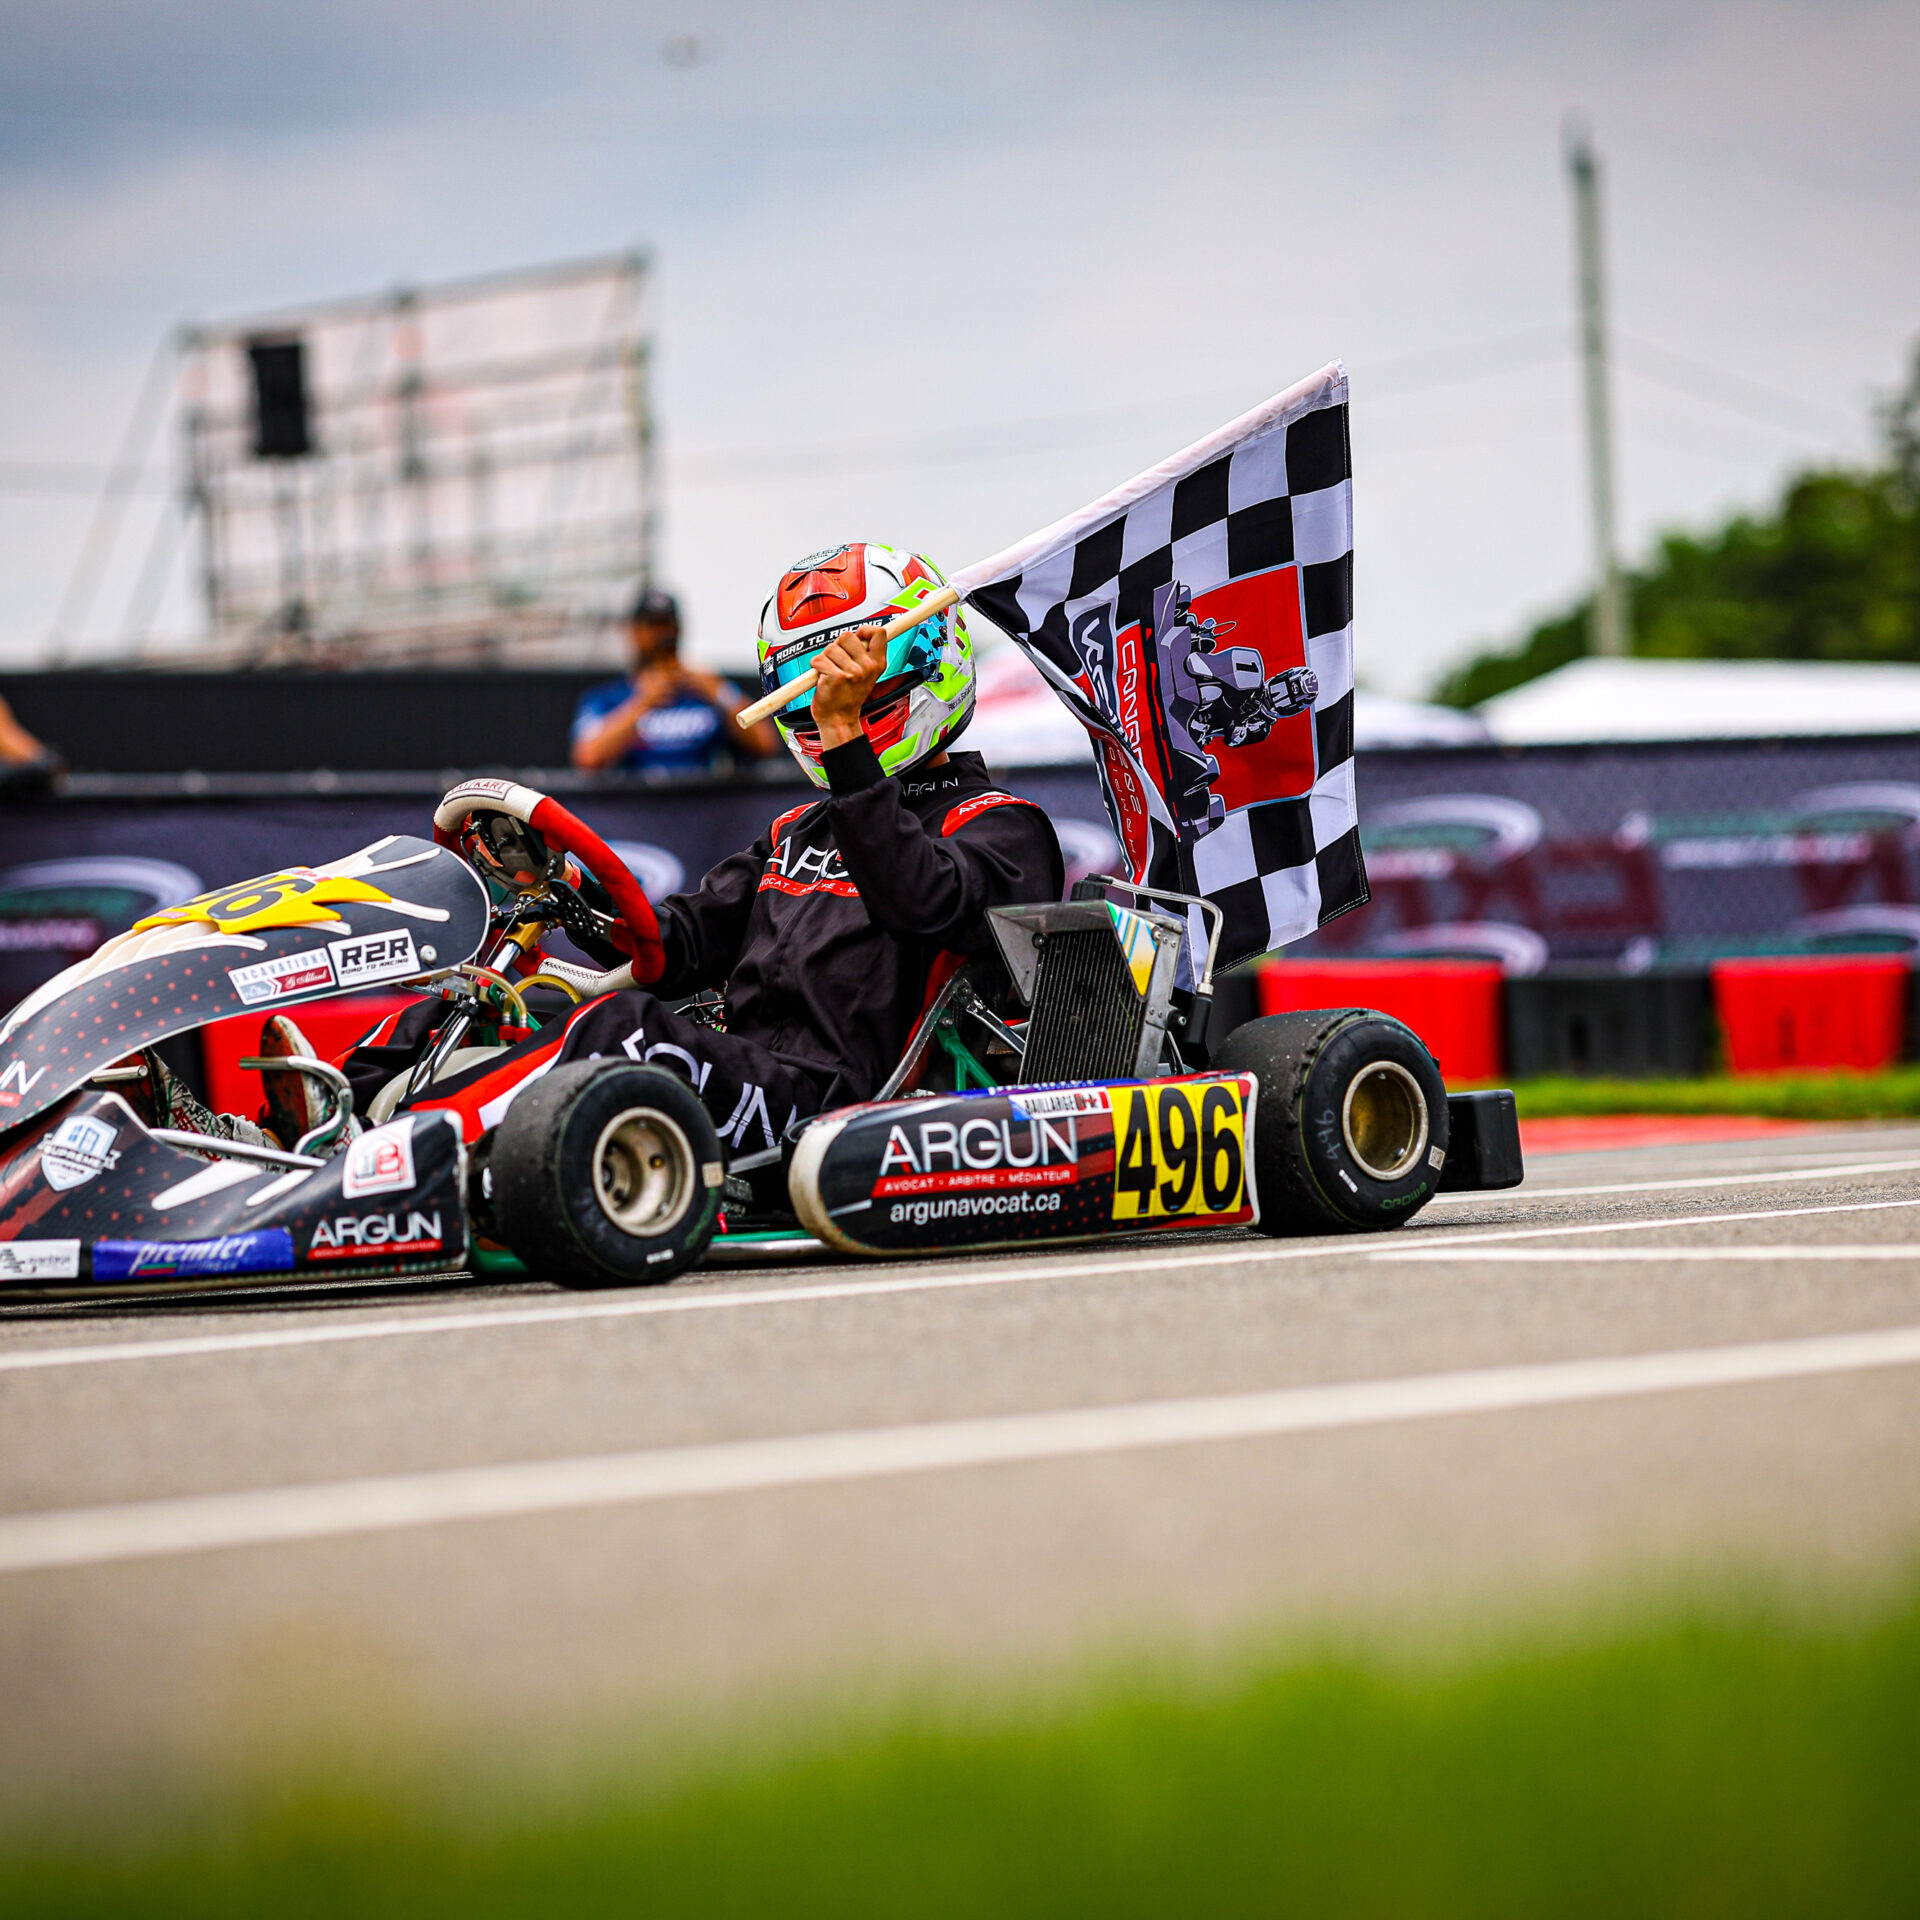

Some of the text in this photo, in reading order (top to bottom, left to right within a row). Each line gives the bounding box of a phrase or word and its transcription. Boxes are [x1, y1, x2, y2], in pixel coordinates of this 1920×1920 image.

[776, 641, 804, 662] ROAD
[807, 633, 825, 646] TO
[232, 951, 327, 984] EXCAVATIONS
[340, 936, 409, 969] R2R
[879, 1116, 1079, 1177] ARGUN
[1117, 1086, 1242, 1215] 496
[1315, 1108, 1341, 1161] 496
[884, 1177, 935, 1192] AVOCAT
[948, 1173, 997, 1186] ARBITRE
[890, 1190, 1061, 1225] argunavocat.ca
[311, 1210, 442, 1249] ARGUN
[128, 1235, 257, 1276] premier
